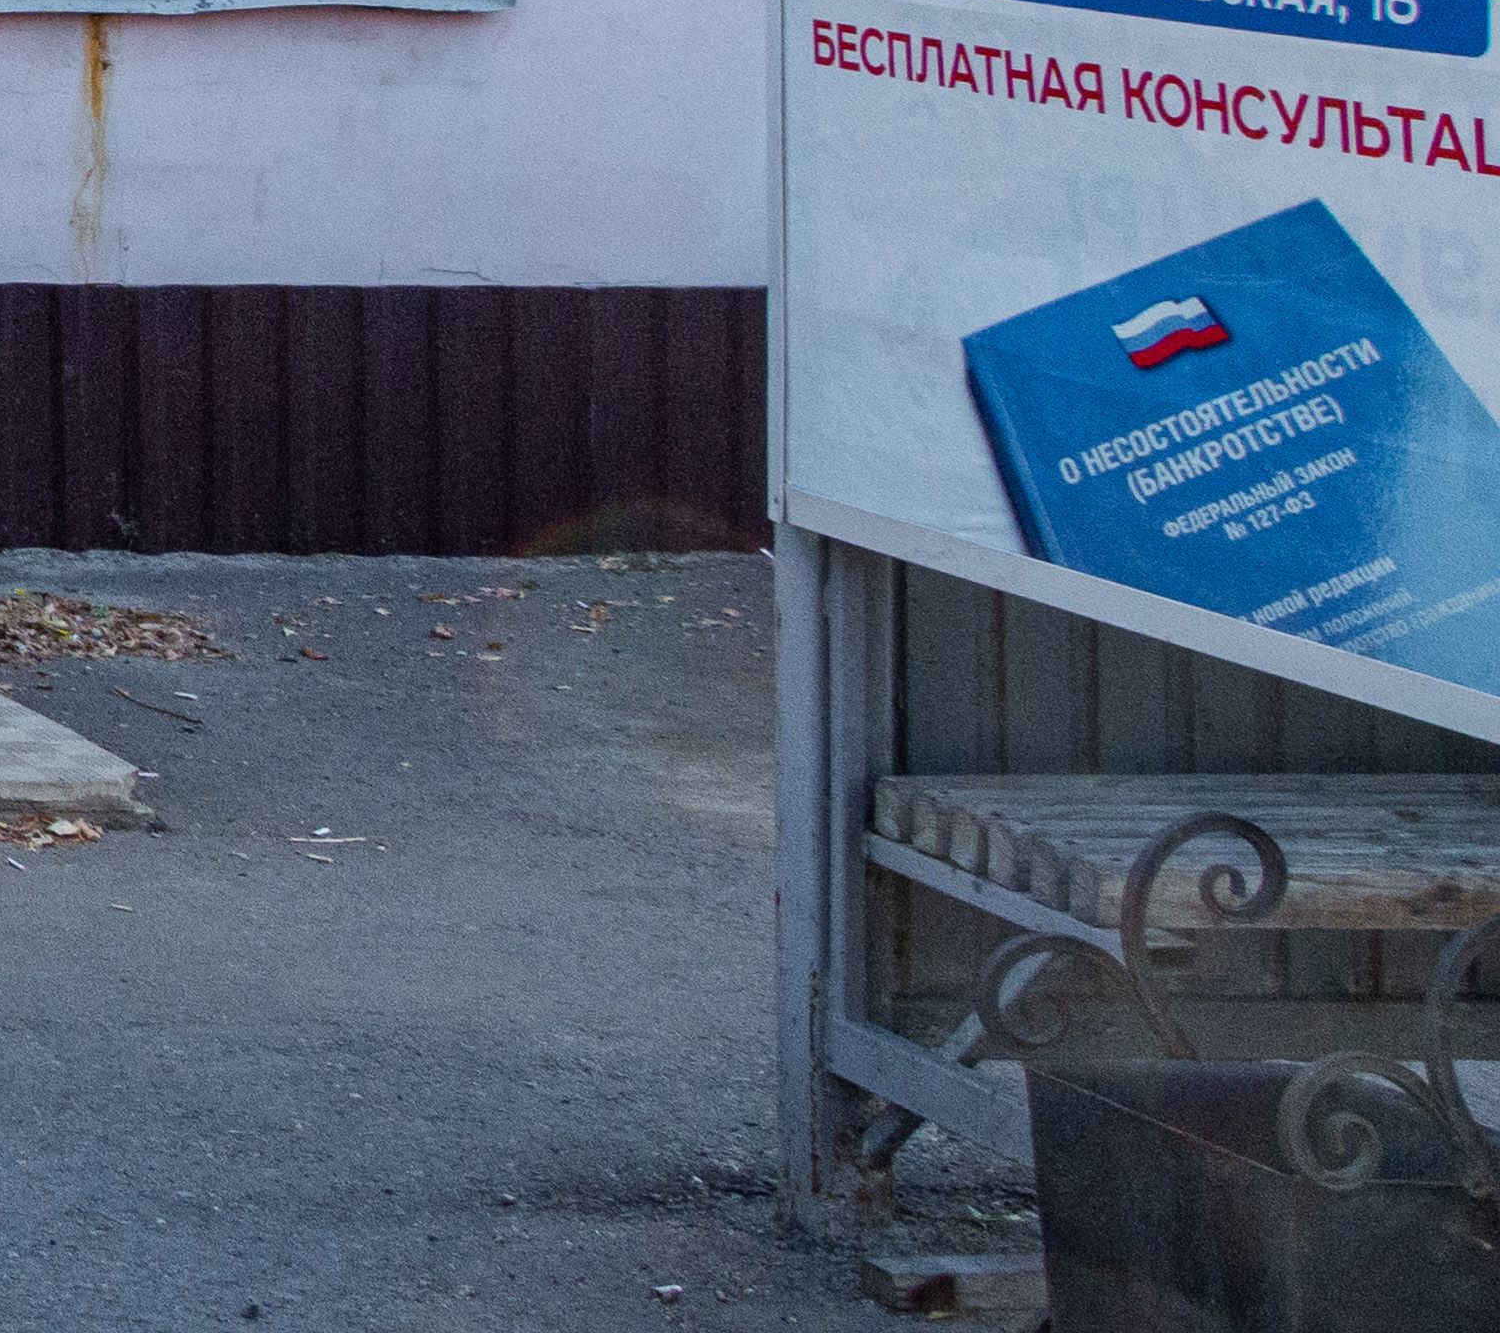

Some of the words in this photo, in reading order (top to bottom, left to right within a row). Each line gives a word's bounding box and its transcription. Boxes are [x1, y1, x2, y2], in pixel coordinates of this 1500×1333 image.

[813, 19, 1106, 114] БЕСПЛАТНАЯ
[1059, 457, 1082, 484] О
[1081, 337, 1382, 477] НЕСОСТОЯТЕЛЬНОСТИ
[1125, 393, 1345, 505] (БАНКРОТСТВЕ)
[1163, 469, 1297, 538] ФЕДЕРАЛЬНЫЙ
[1295, 446, 1358, 486] ЗАКОН
[1250, 490, 1317, 532] 127-ФЗ
[1252, 588, 1310, 626] новой
[1307, 555, 1398, 608] редакции
